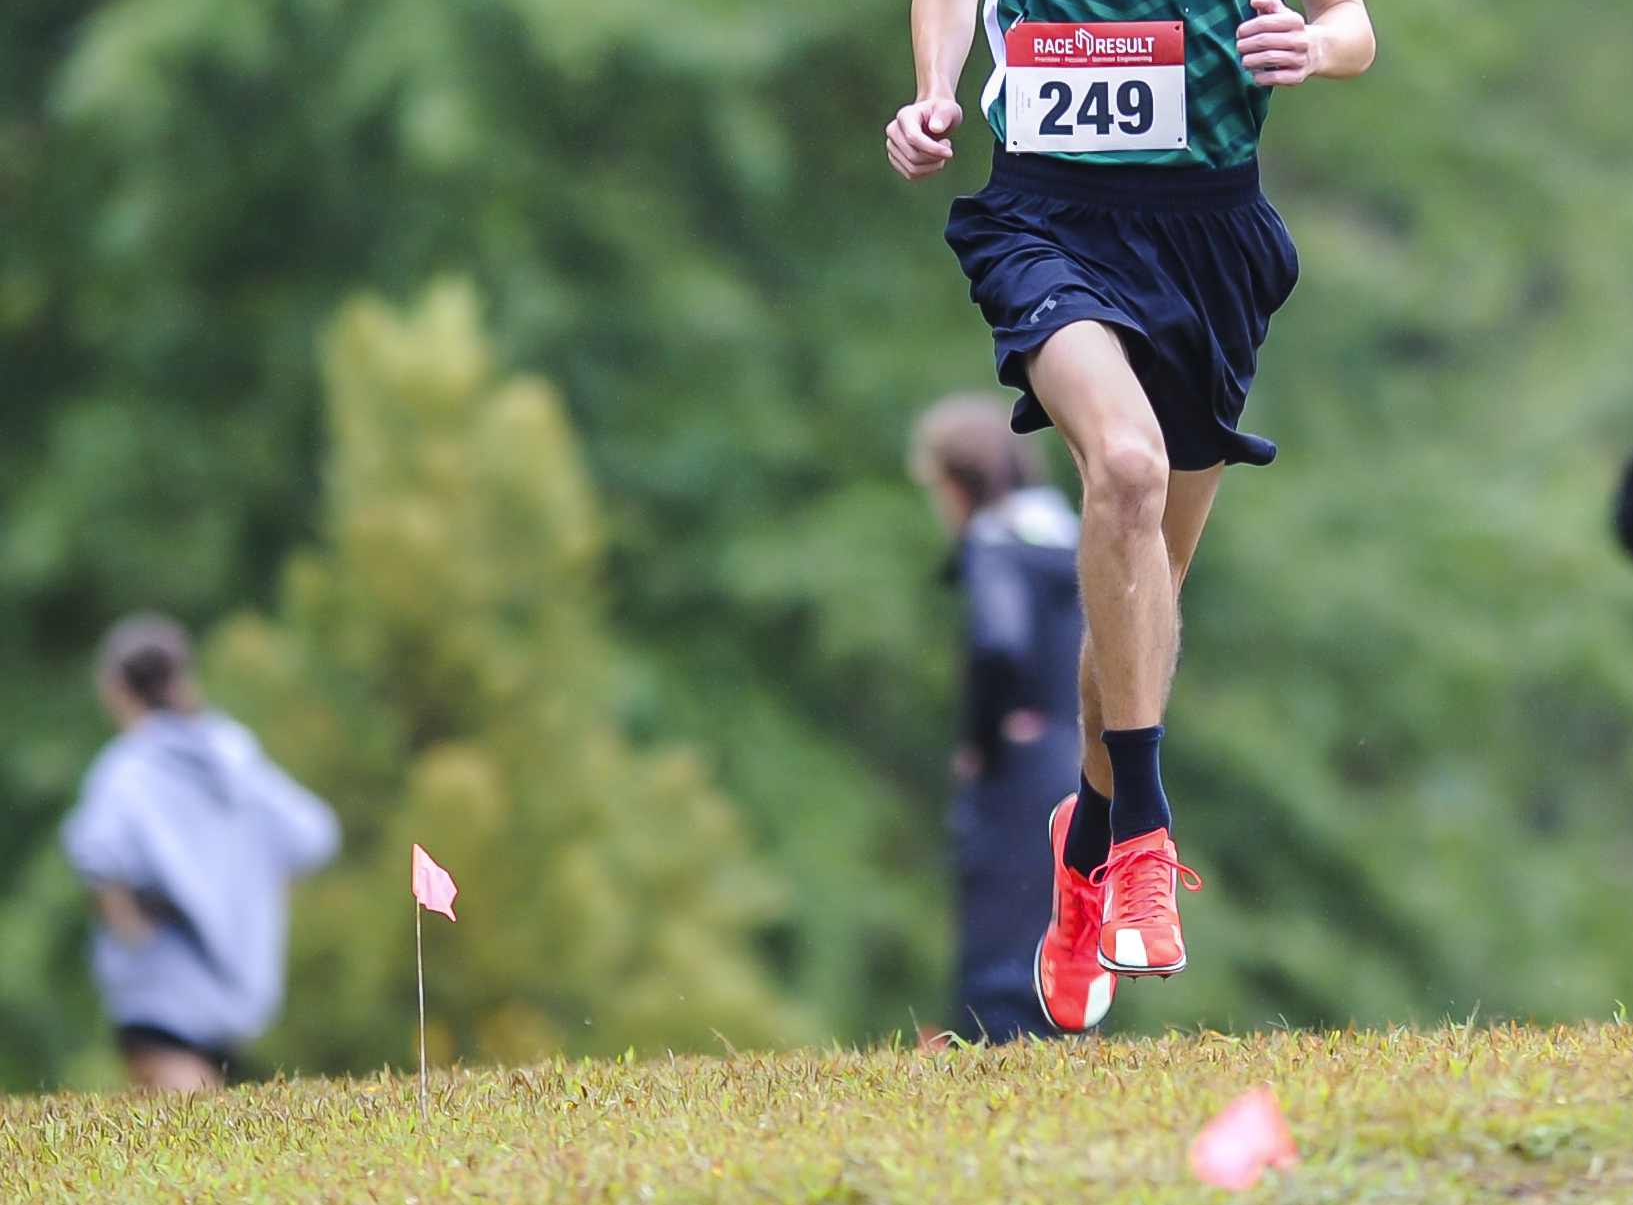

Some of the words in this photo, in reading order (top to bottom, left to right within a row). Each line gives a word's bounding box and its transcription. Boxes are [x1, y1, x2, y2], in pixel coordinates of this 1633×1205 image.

[1033, 38, 1074, 54] RACE
[1095, 36, 1155, 54] RESULT
[1038, 80, 1154, 136] 249
